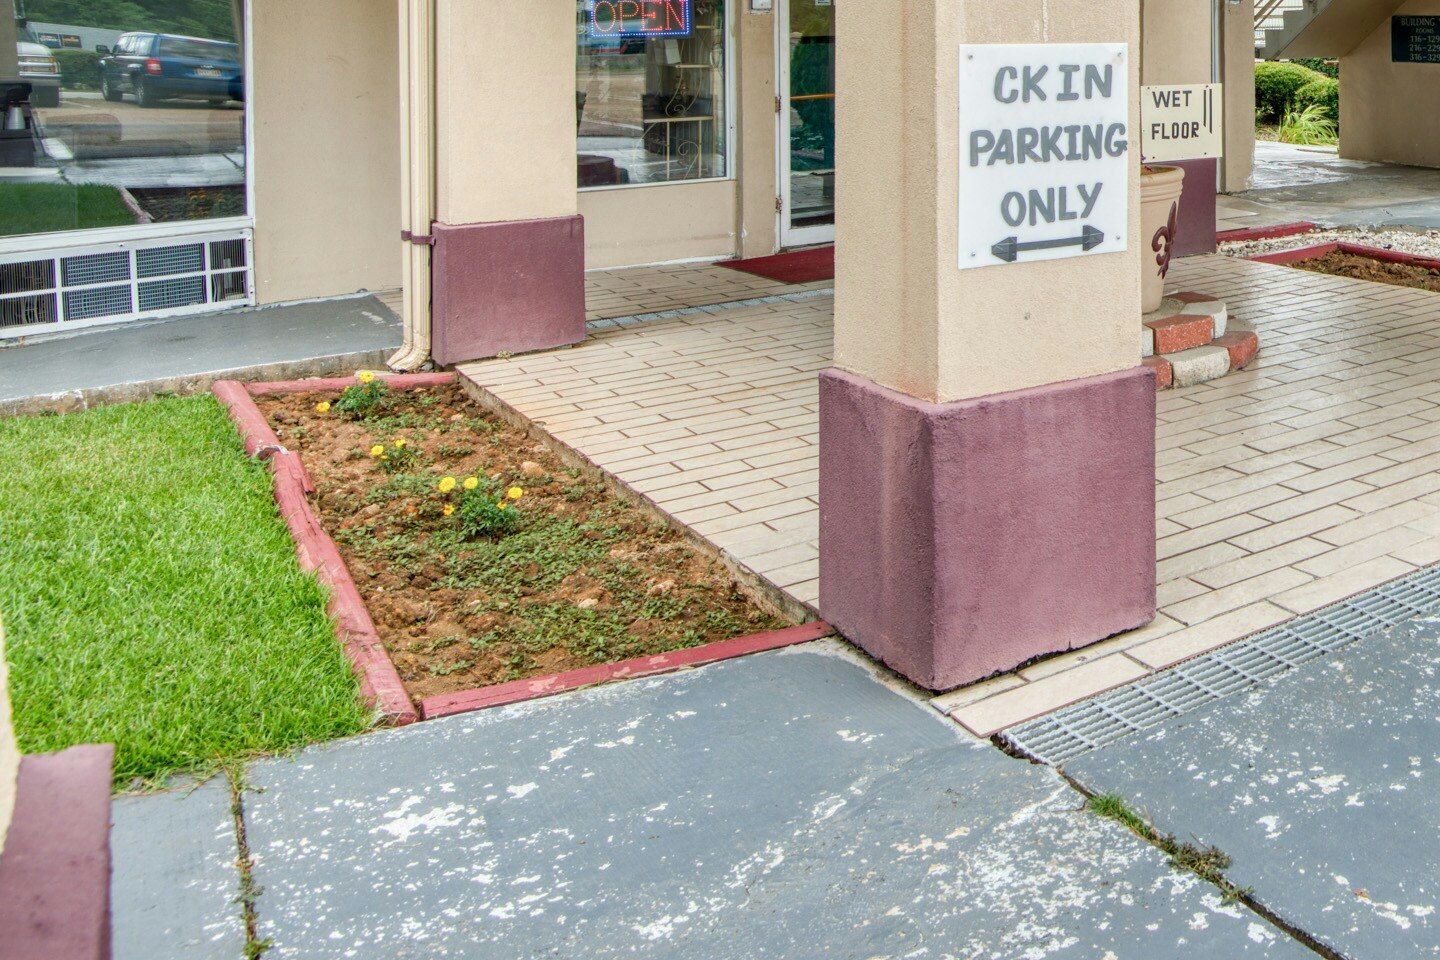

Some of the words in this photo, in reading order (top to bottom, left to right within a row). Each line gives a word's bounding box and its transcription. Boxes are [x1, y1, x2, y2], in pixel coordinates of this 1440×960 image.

[1401, 17, 1435, 27] BUILDING
[1409, 53, 1440, 62] 316-329
[1152, 90, 1193, 108] WET
[1151, 121, 1200, 140] FLOOR
[969, 122, 1128, 167] PARKING
[1000, 182, 1104, 227] ONLY
